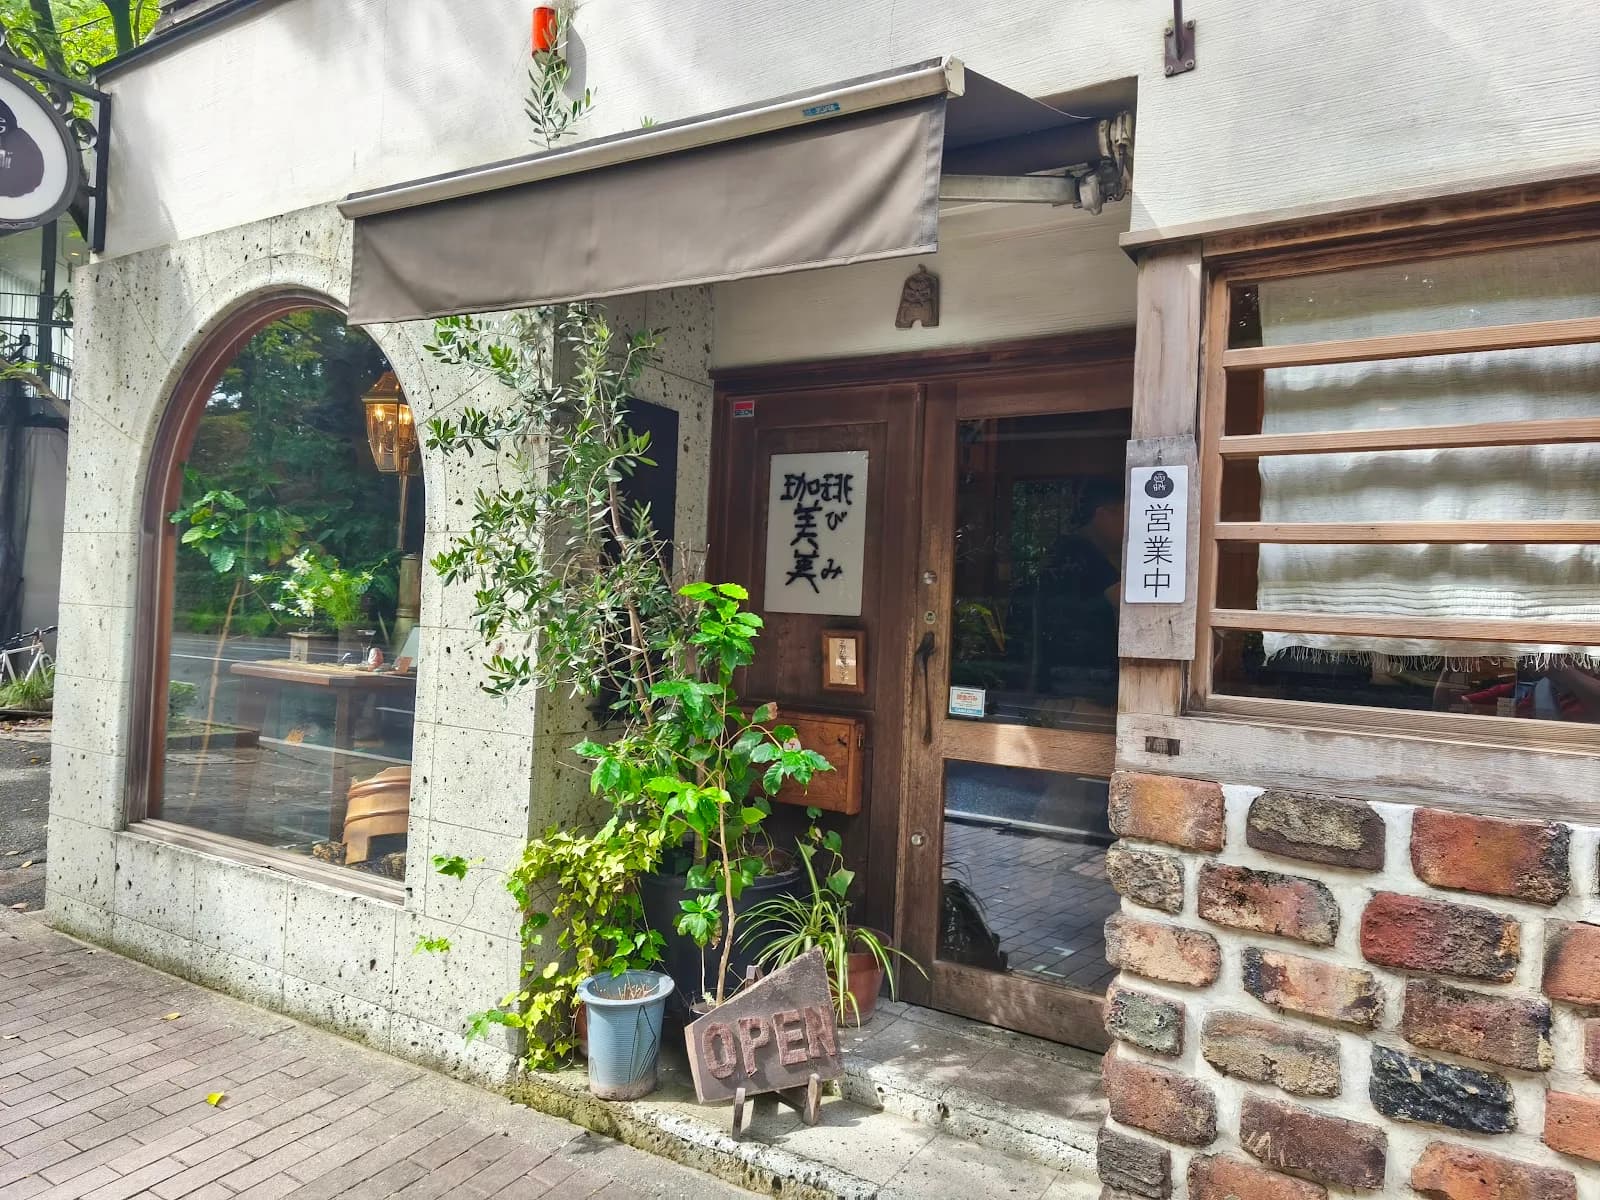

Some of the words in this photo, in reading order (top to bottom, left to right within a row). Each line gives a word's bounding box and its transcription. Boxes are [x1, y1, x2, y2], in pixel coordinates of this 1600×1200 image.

[780, 472, 854, 505] 珈琲
[1143, 503, 1174, 599] 営業中
[702, 1004, 837, 1080] OPEN
